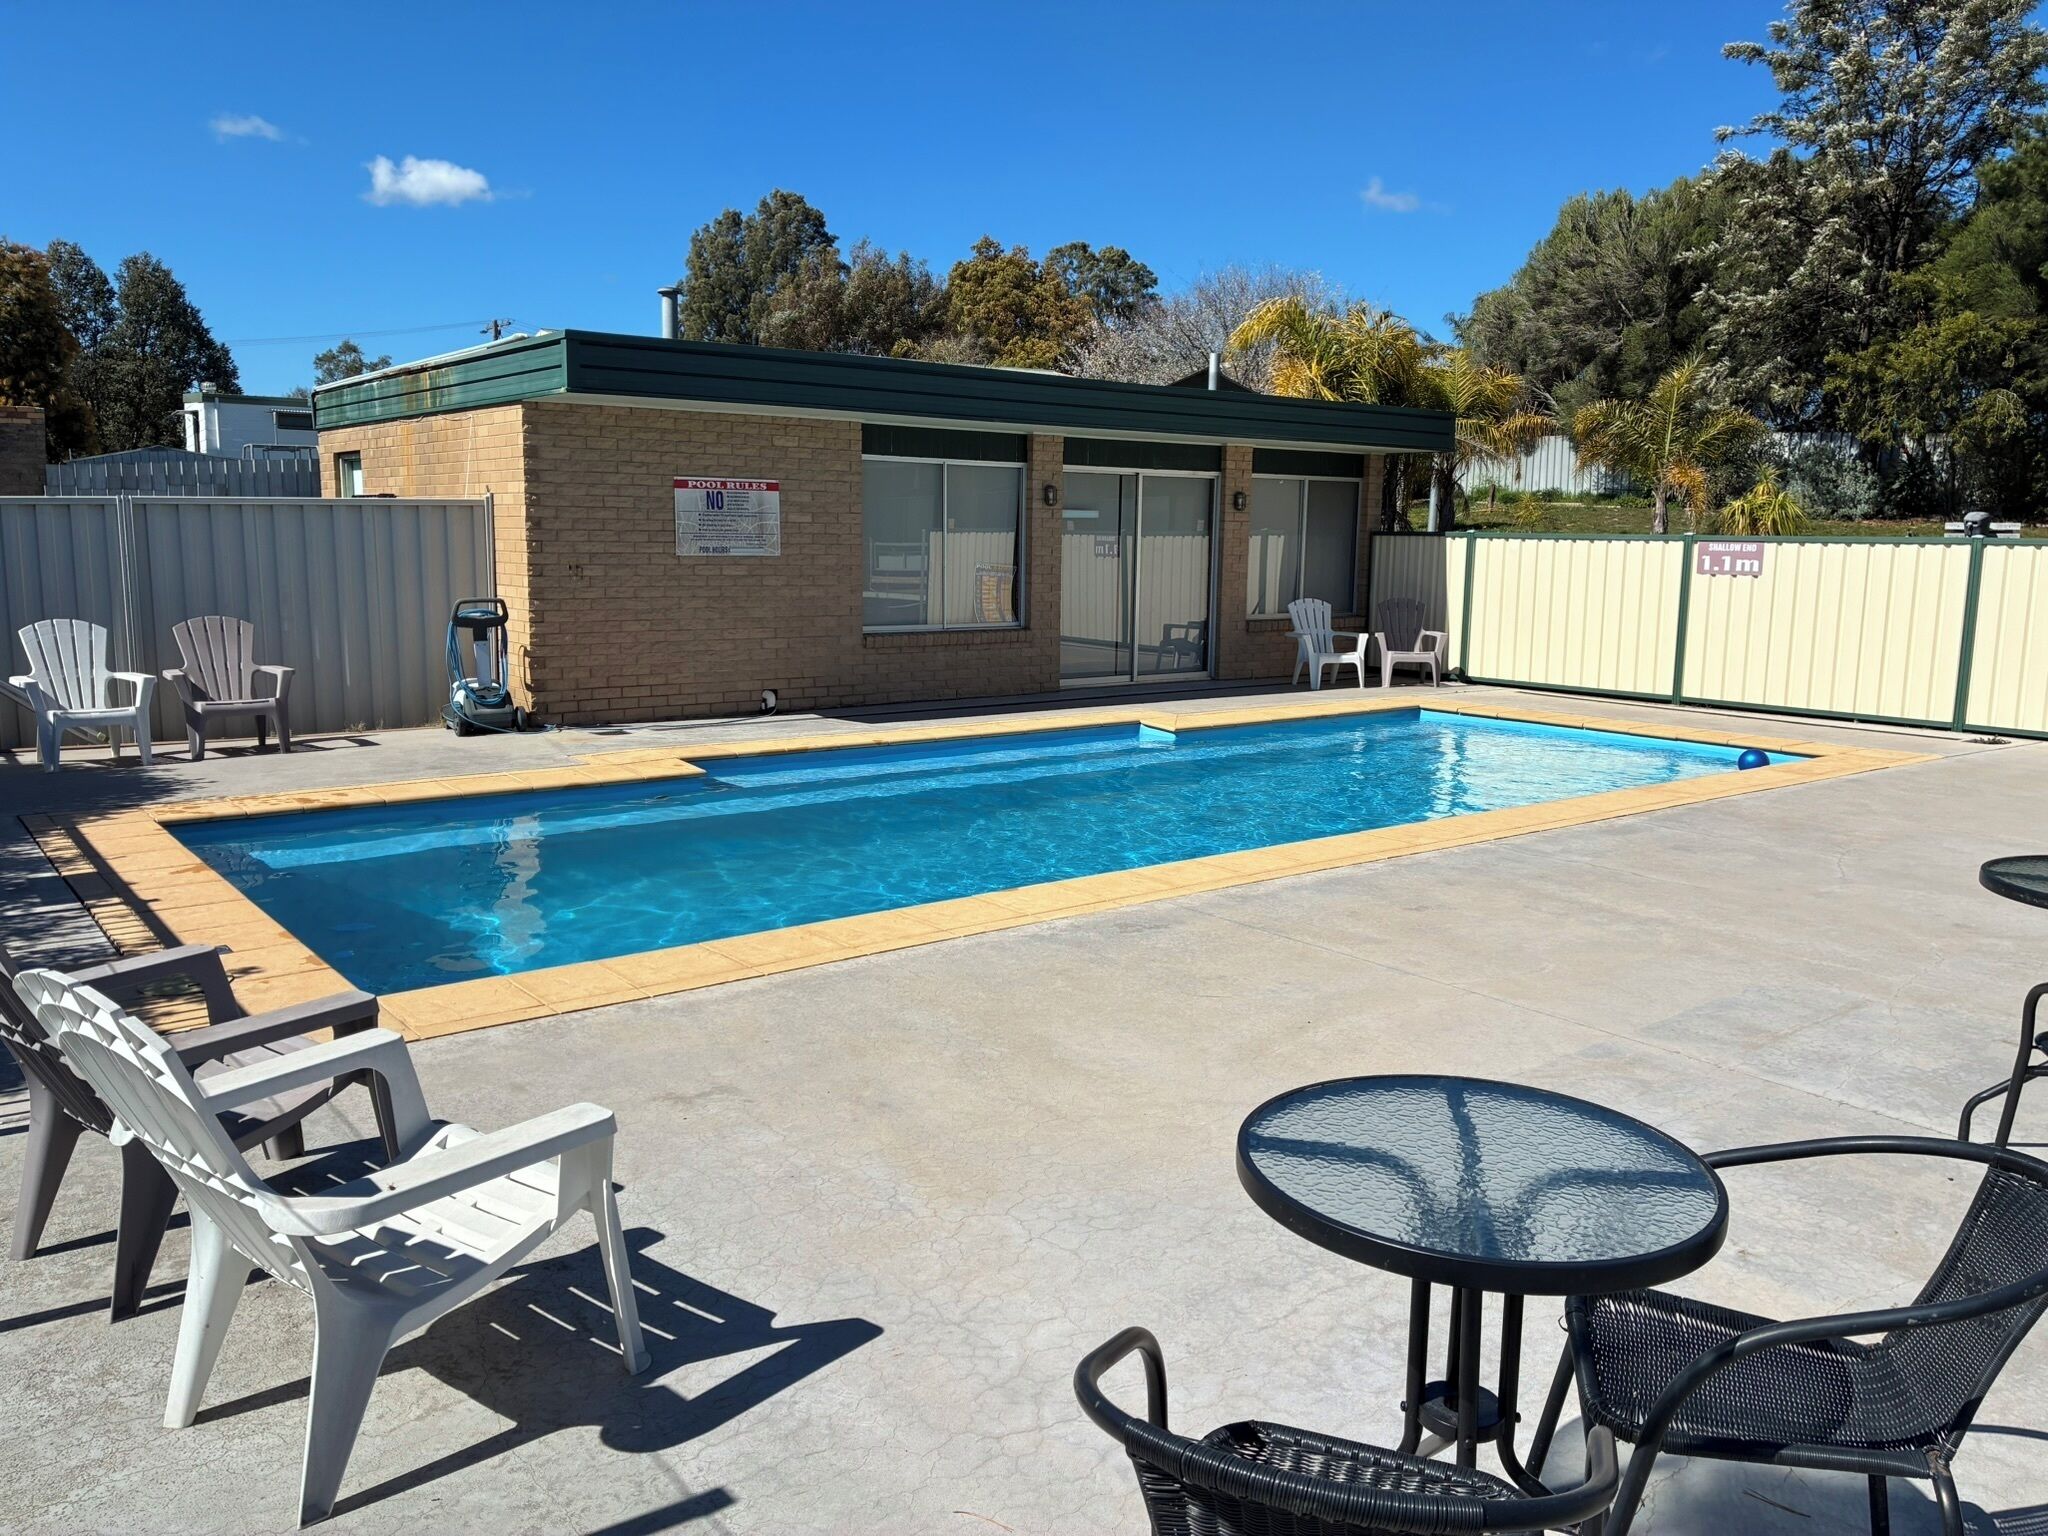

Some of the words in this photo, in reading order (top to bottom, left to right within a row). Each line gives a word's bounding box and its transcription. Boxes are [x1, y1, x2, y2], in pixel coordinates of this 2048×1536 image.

[688, 480, 724, 489] POOL
[726, 481, 768, 490] RULES
[706, 490, 724, 511] NO
[1708, 543, 1742, 552] SHALLOW
[1742, 544, 1757, 552] END
[1701, 555, 1760, 572] 1.1m
